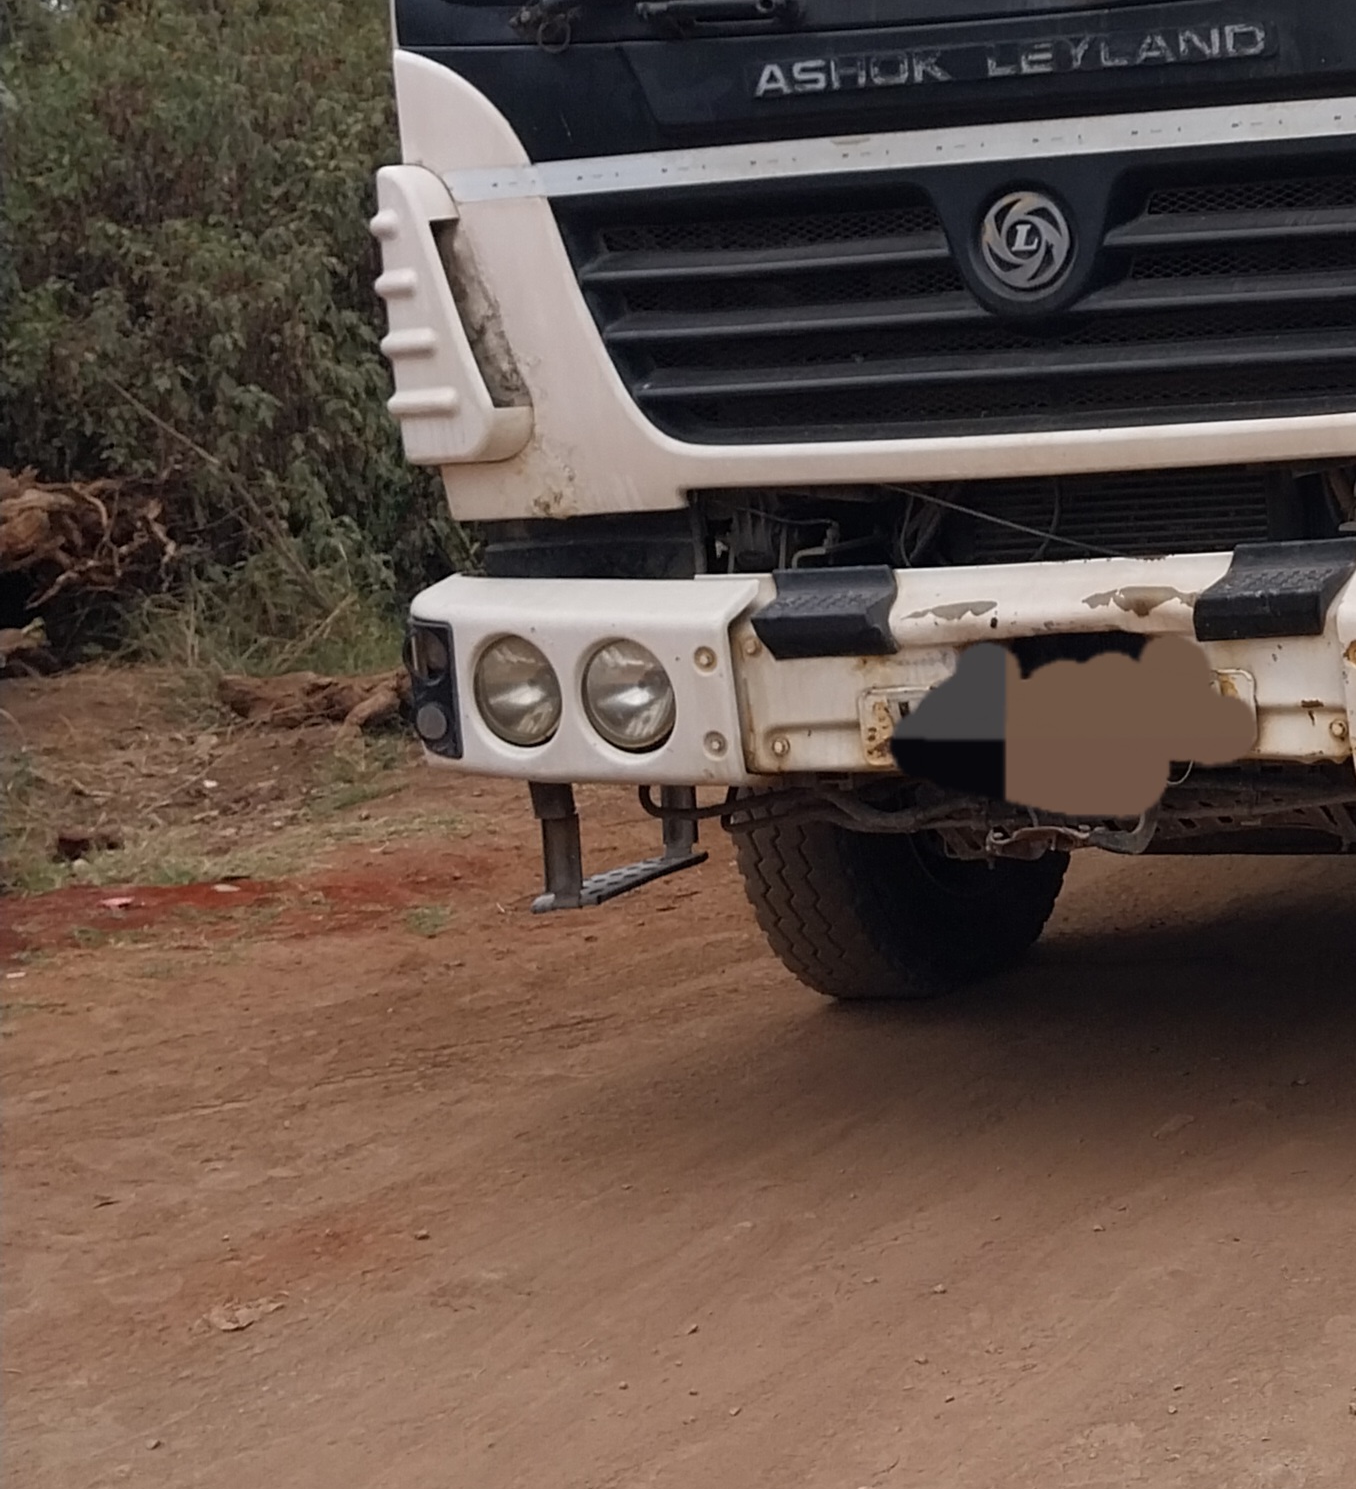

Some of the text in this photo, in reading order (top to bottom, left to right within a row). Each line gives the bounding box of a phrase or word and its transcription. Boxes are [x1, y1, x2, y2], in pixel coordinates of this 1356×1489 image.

[754, 22, 1267, 97] ASHOK LEYLAND
[1011, 223, 1039, 252] L
